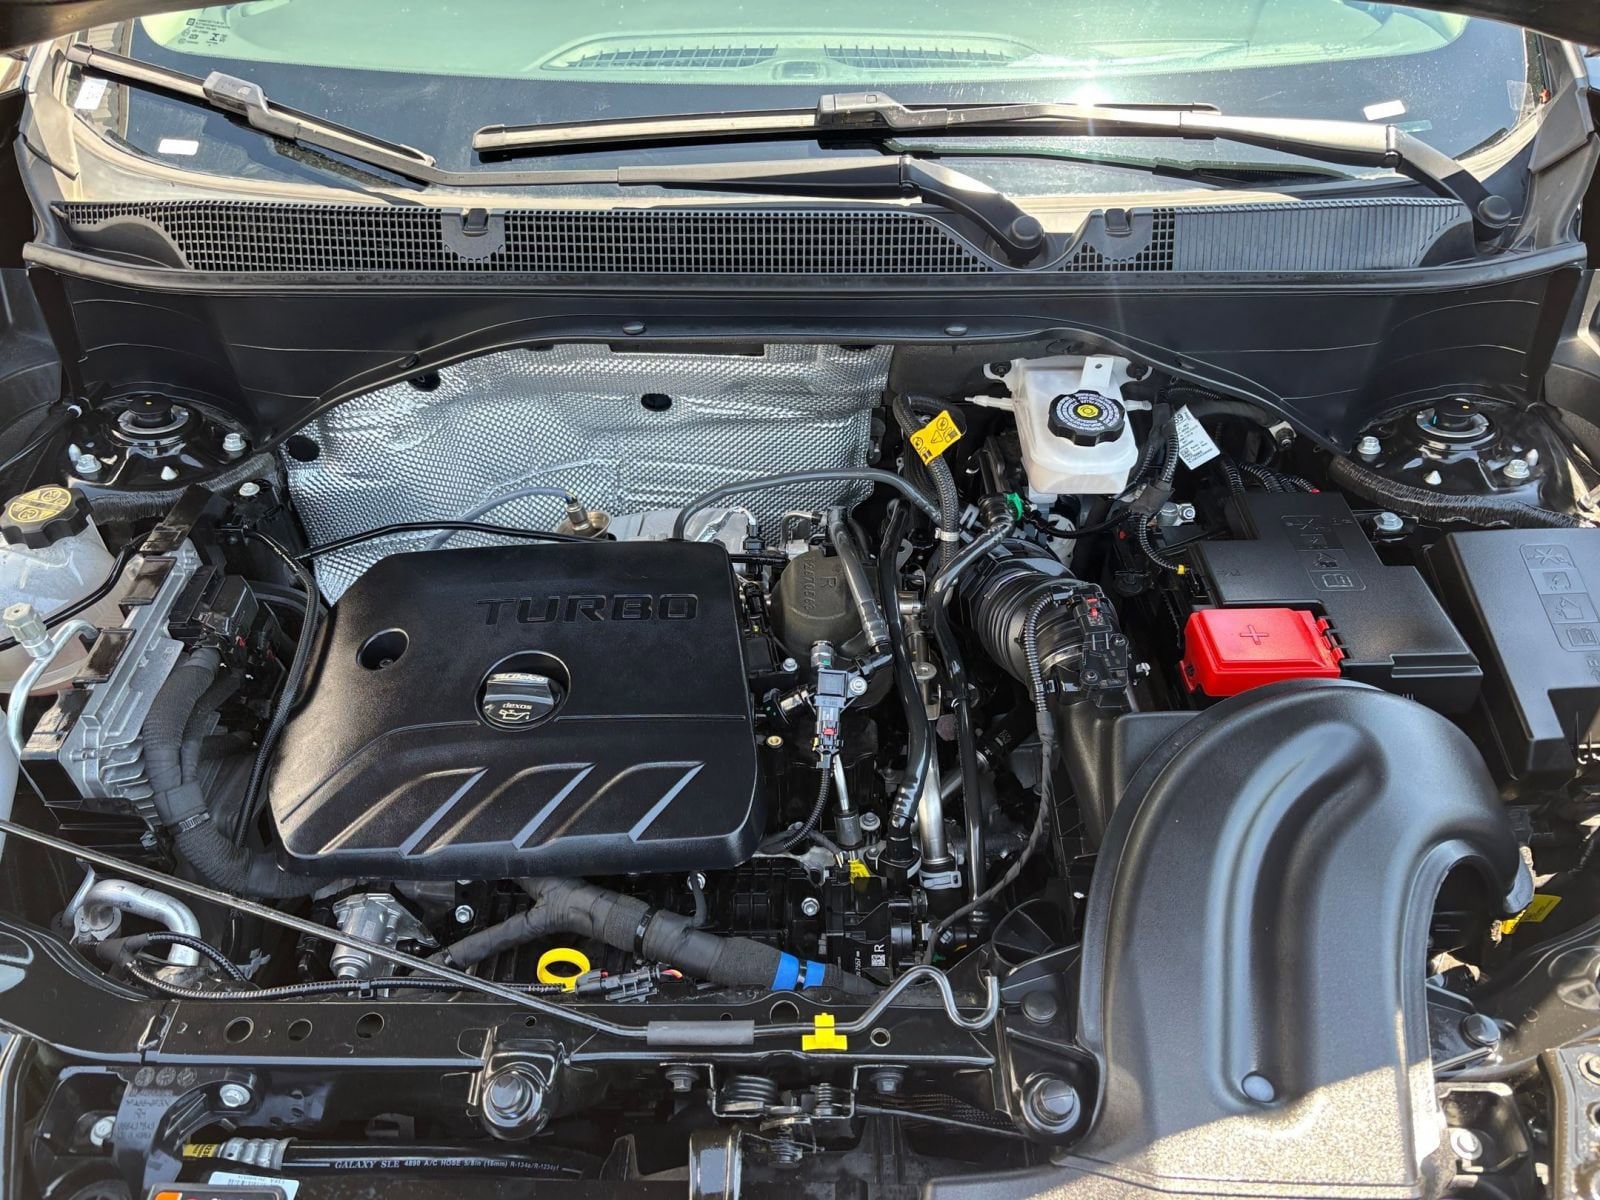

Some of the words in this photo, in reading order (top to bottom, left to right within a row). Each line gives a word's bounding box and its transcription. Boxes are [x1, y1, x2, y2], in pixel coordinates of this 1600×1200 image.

[476, 593, 699, 626] TURBO
[502, 702, 533, 711] dexos
[874, 944, 885, 952] R
[334, 1160, 377, 1169] GALAXY
[380, 1160, 400, 1169] SLE
[424, 1159, 438, 1167] A/C
